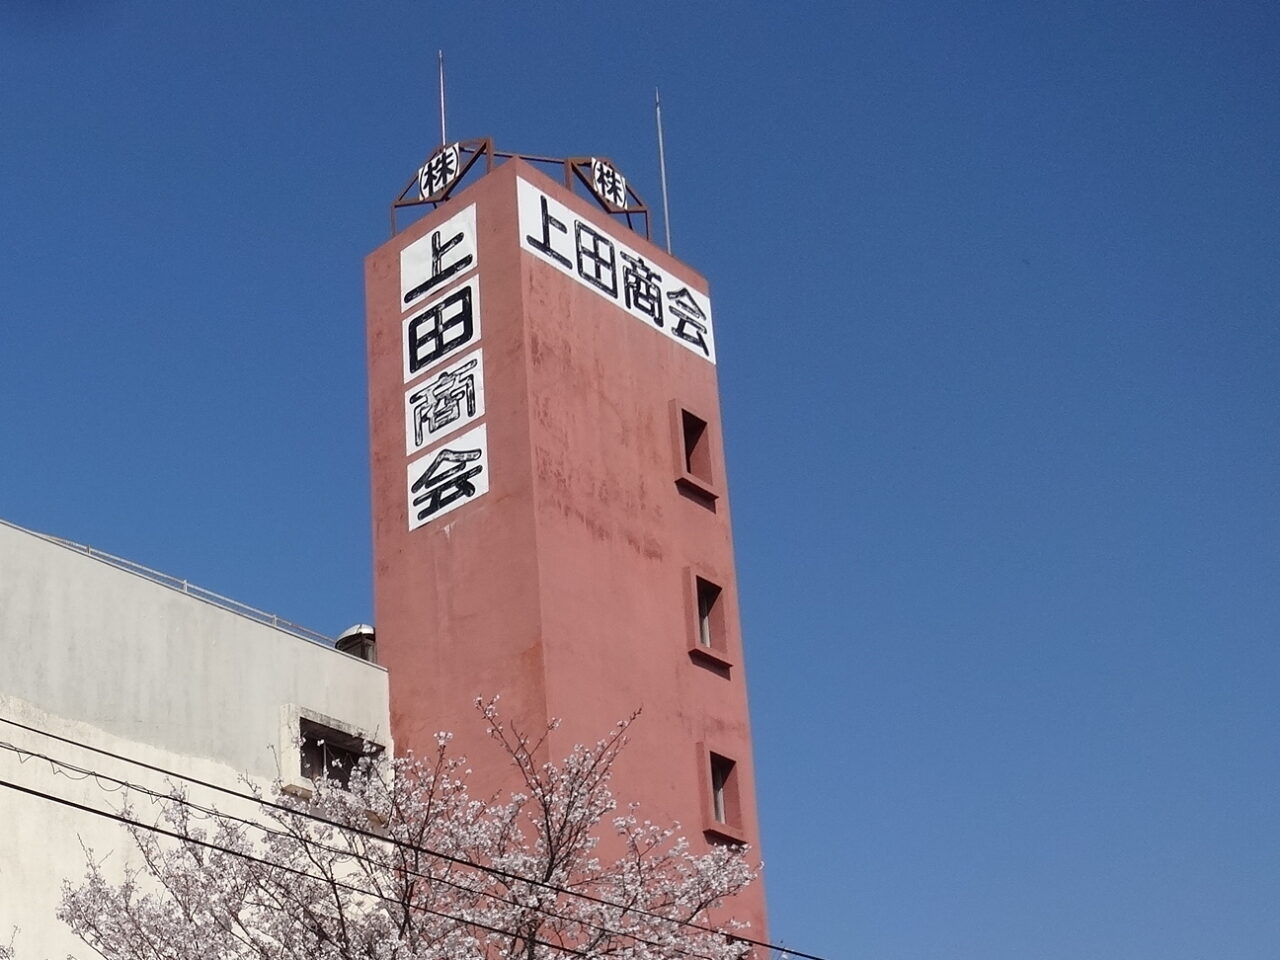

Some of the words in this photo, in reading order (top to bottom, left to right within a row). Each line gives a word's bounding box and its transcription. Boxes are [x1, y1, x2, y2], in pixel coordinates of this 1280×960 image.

[404, 231, 483, 521] 上田商会
[526, 195, 710, 357] 上田商会
